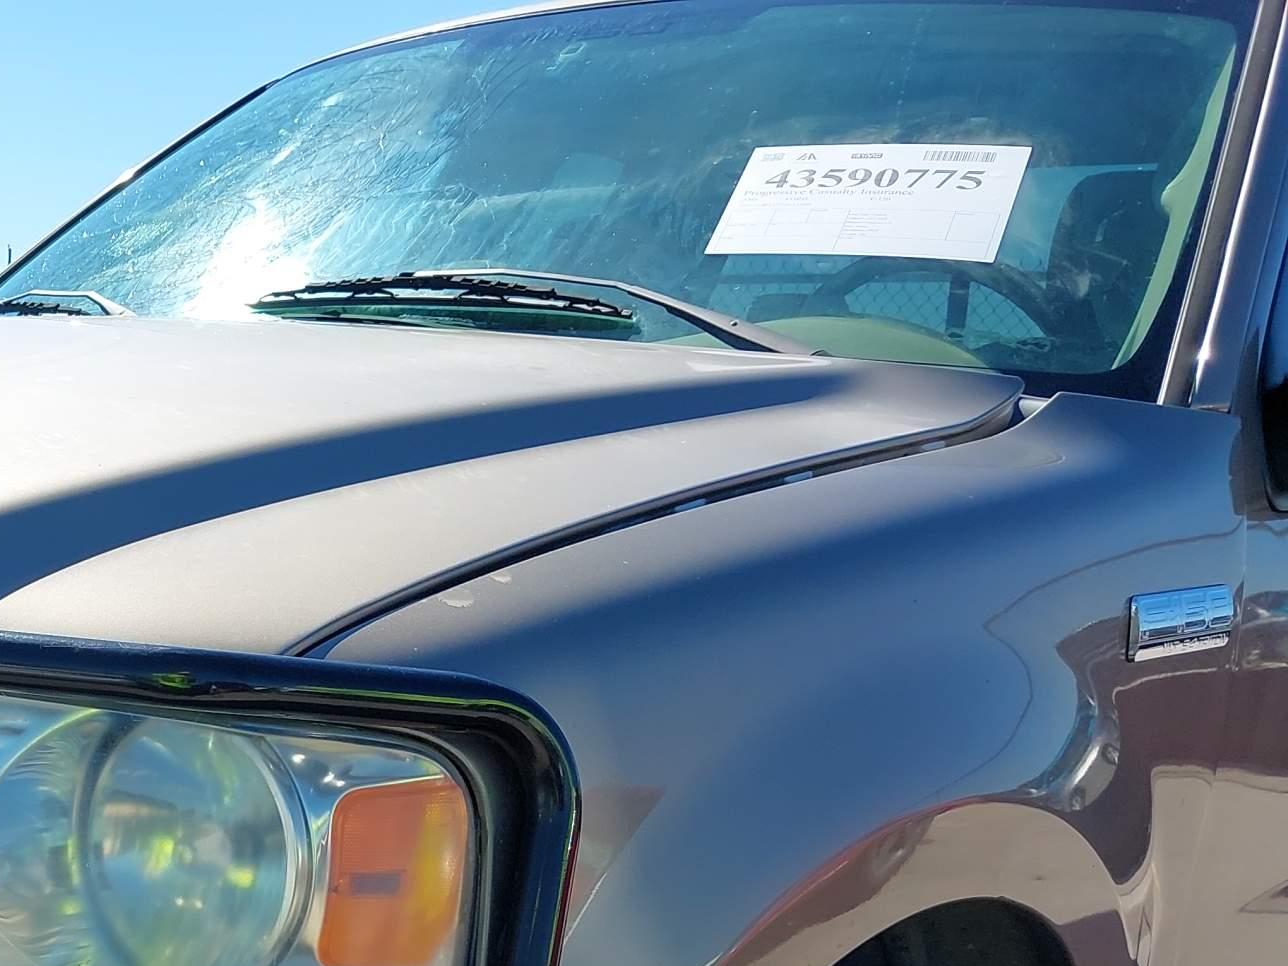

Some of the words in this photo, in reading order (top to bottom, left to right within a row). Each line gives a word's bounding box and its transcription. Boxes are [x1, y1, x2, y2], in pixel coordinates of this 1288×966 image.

[766, 168, 984, 190] 43590775
[744, 189, 807, 197] Progressive
[809, 189, 857, 197] Casualty
